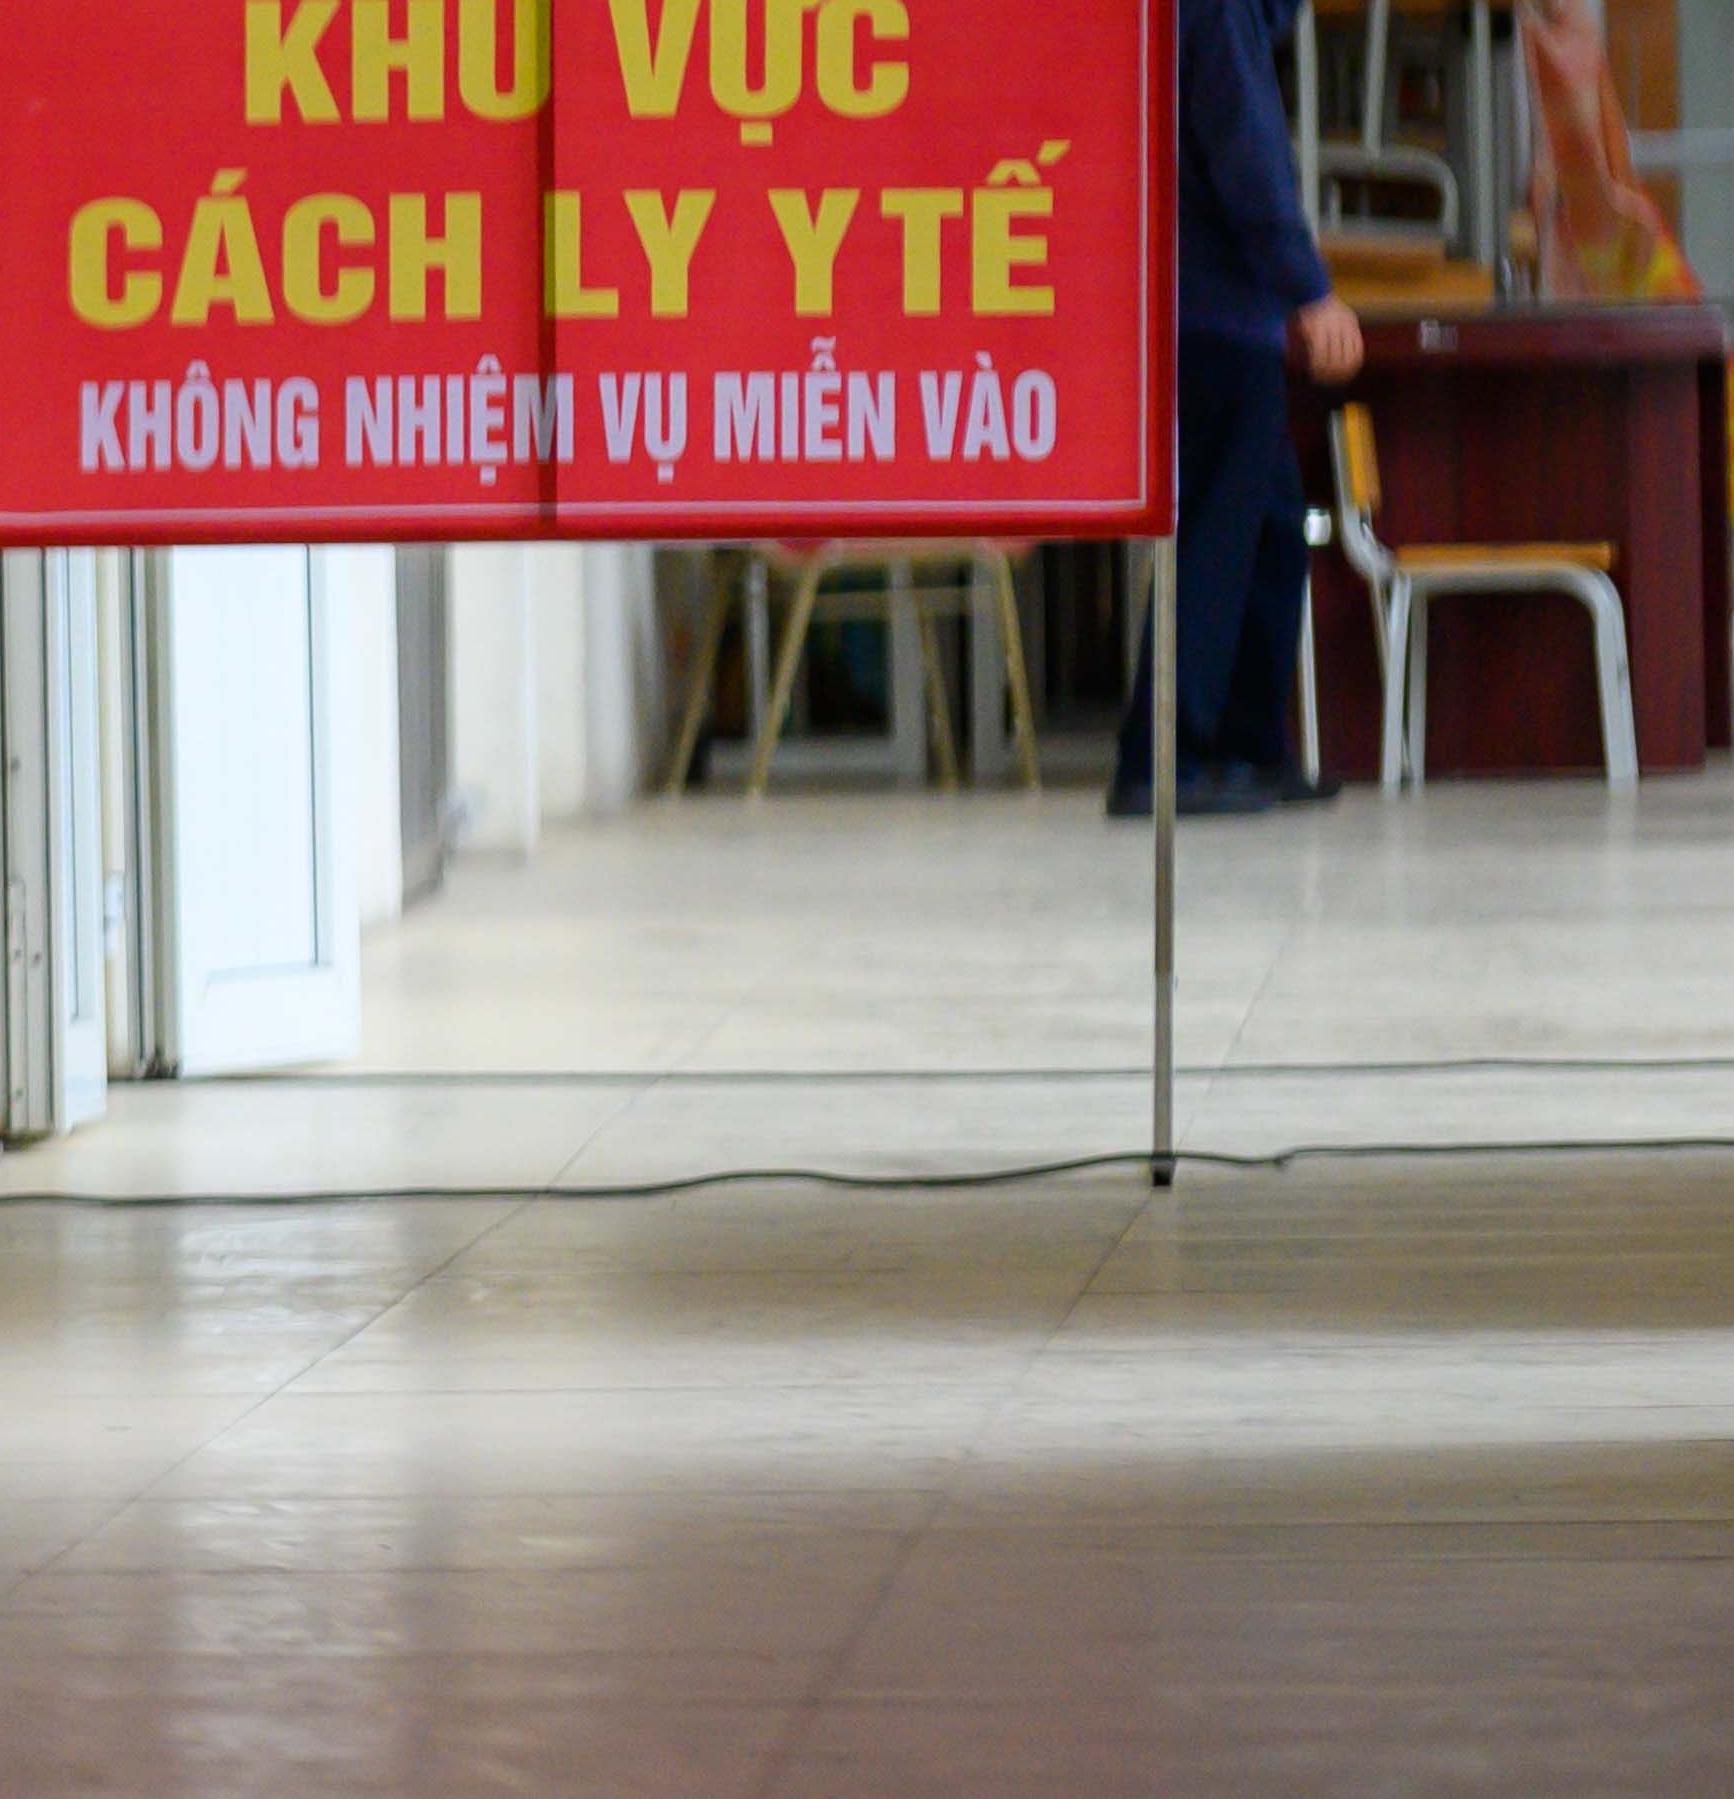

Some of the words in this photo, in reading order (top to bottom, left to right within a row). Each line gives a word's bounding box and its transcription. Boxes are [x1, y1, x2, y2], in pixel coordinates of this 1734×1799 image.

[68, 168, 483, 330] CÁCH
[544, 188, 716, 319] LY
[78, 359, 320, 474] KHÔNG
[344, 354, 575, 486] NHIỆM
[598, 371, 688, 484] VỤ
[713, 335, 896, 463] MIỄN
[919, 350, 1057, 464] VÀO
